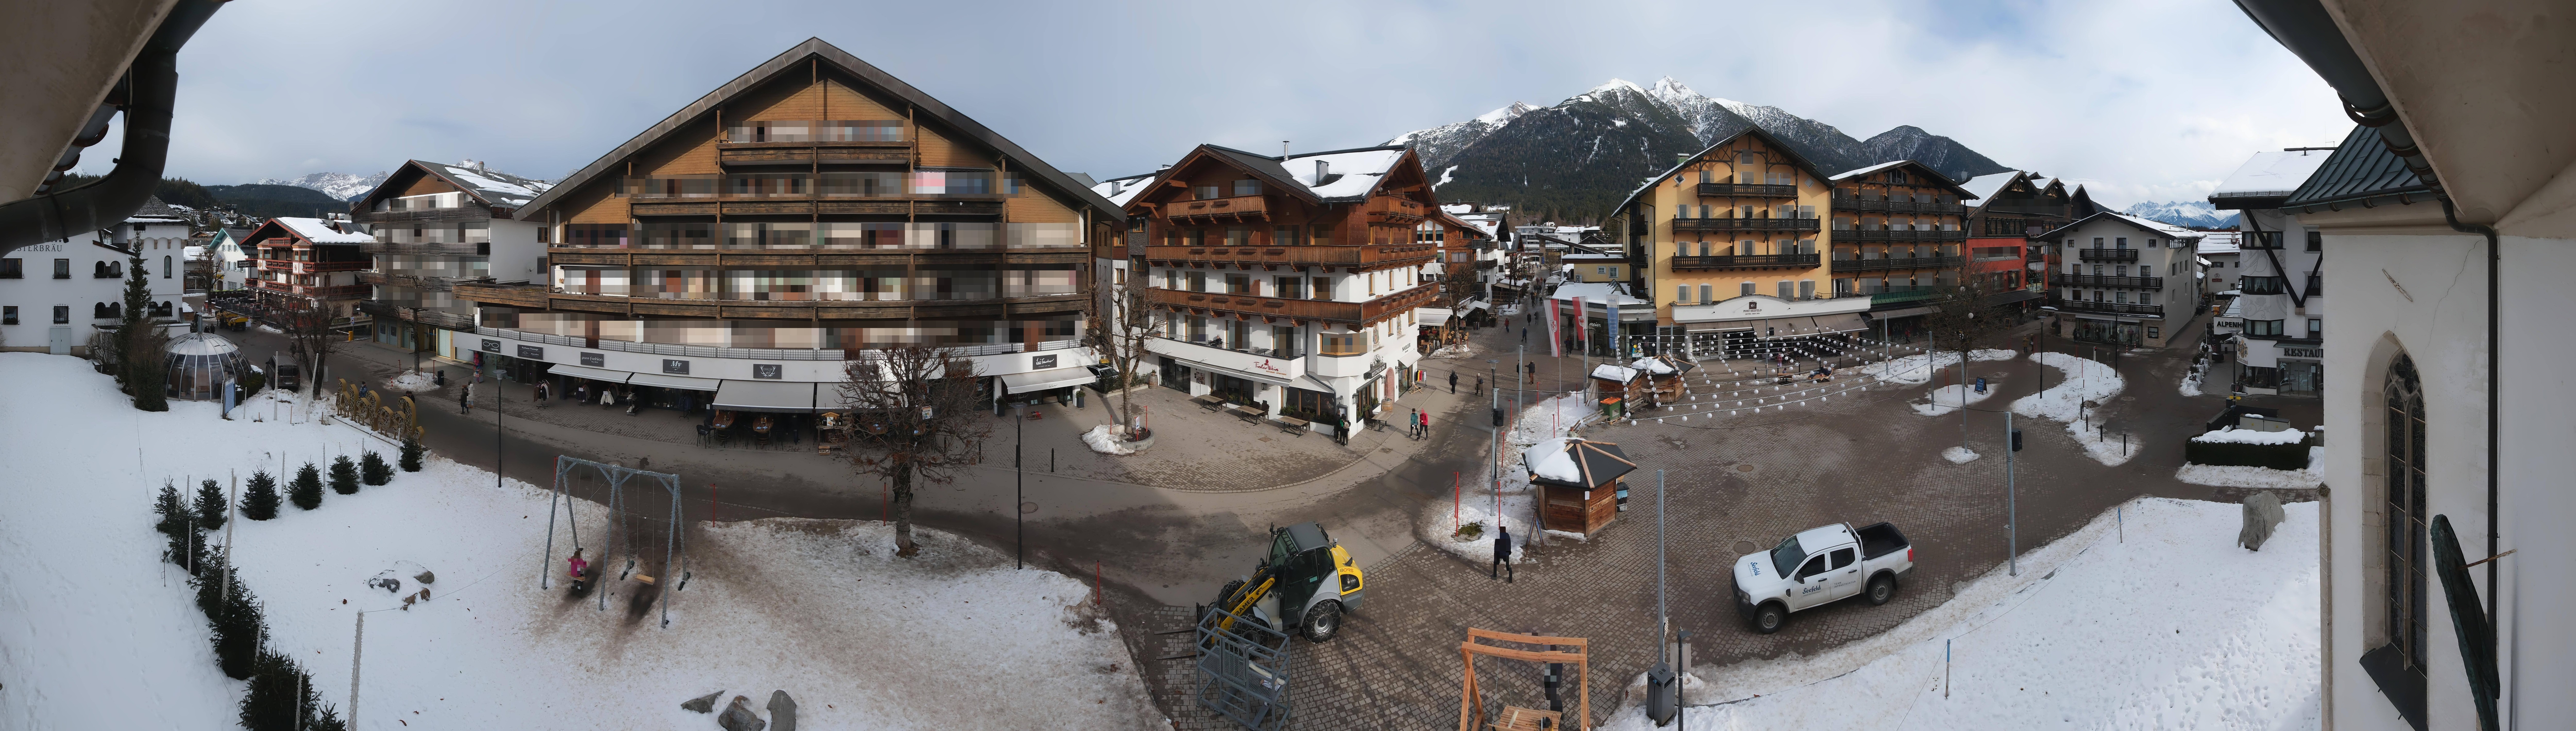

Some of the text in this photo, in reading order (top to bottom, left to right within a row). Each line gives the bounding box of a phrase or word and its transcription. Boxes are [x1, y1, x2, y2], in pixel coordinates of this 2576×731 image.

[1402, 343, 1411, 352] SAILER
[671, 361, 682, 370] My
[1371, 364, 1385, 377] RESTAURANT
[1750, 562, 1761, 576] Seefeld
[1802, 585, 1821, 594] Seefeld
